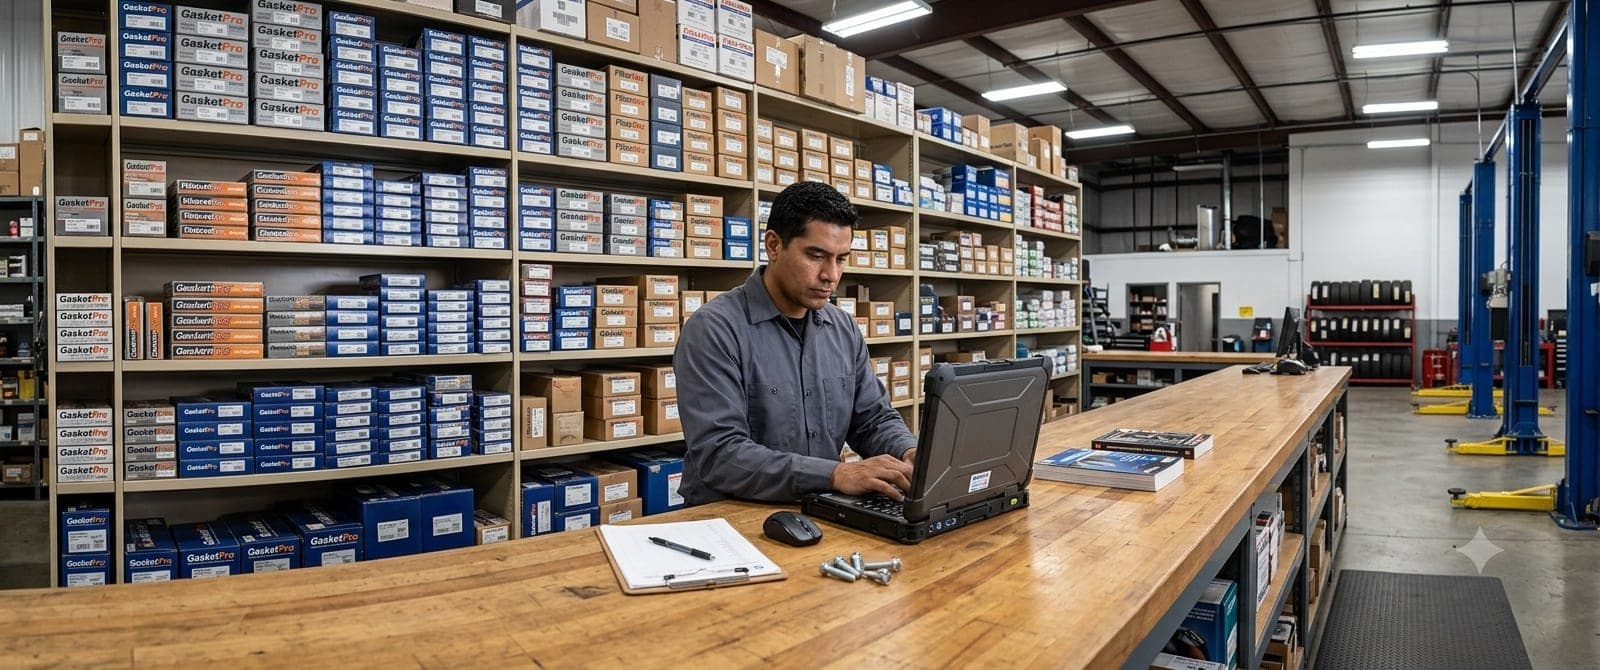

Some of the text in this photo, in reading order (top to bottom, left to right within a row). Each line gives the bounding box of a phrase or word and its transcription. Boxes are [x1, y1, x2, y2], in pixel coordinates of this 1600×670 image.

[181, 9, 243, 25] GasketPro
[258, 25, 317, 41] GasketPro
[180, 38, 243, 53] GasketPro
[259, 49, 319, 65] GasketPro
[181, 66, 243, 82] GasketPro
[260, 75, 319, 90] GasketPro
[181, 94, 244, 109] GasketPro
[260, 102, 319, 116] GasketPro
[310, 532, 359, 546] GasketPro
[187, 551, 235, 563] GasketPro
